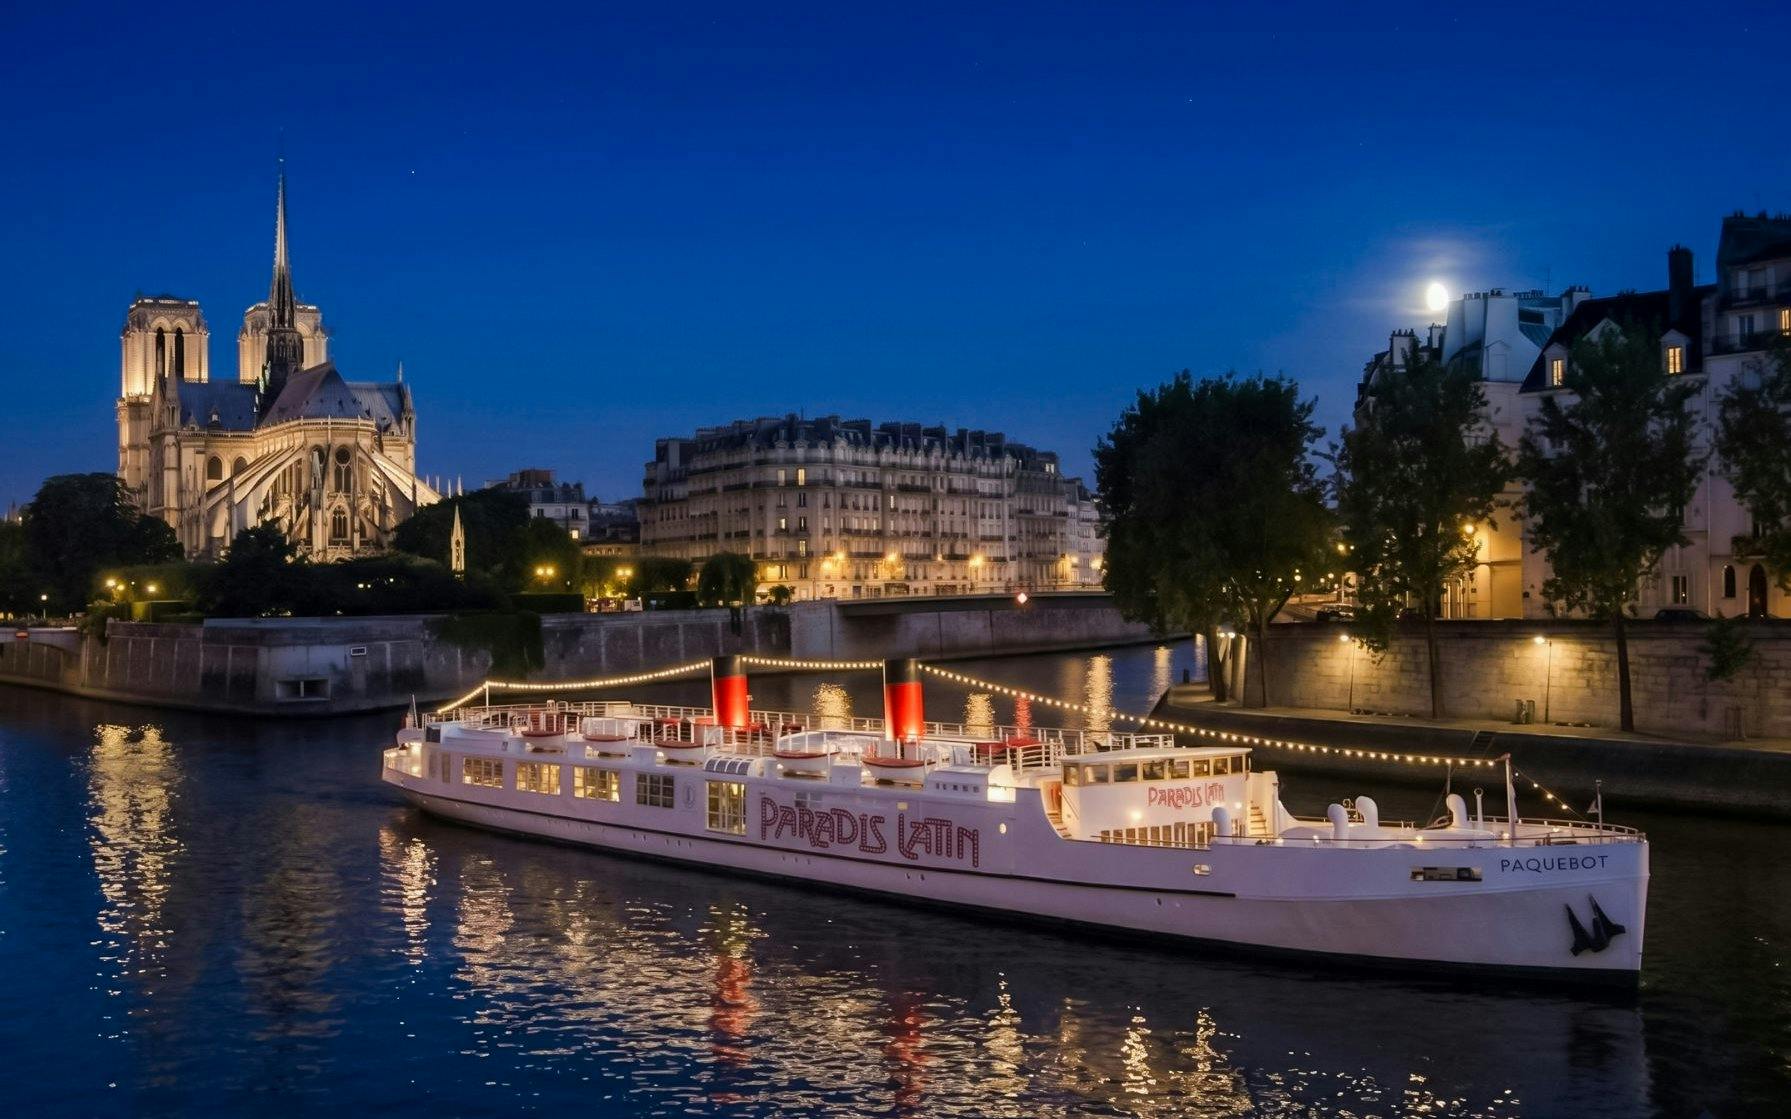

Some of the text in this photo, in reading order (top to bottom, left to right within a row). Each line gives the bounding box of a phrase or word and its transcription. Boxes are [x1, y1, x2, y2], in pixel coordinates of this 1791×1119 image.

[1148, 786, 1202, 809] PARADIS
[760, 797, 979, 868] PARADIS LATIN
[1500, 855, 1609, 873] PAQUEBOT
